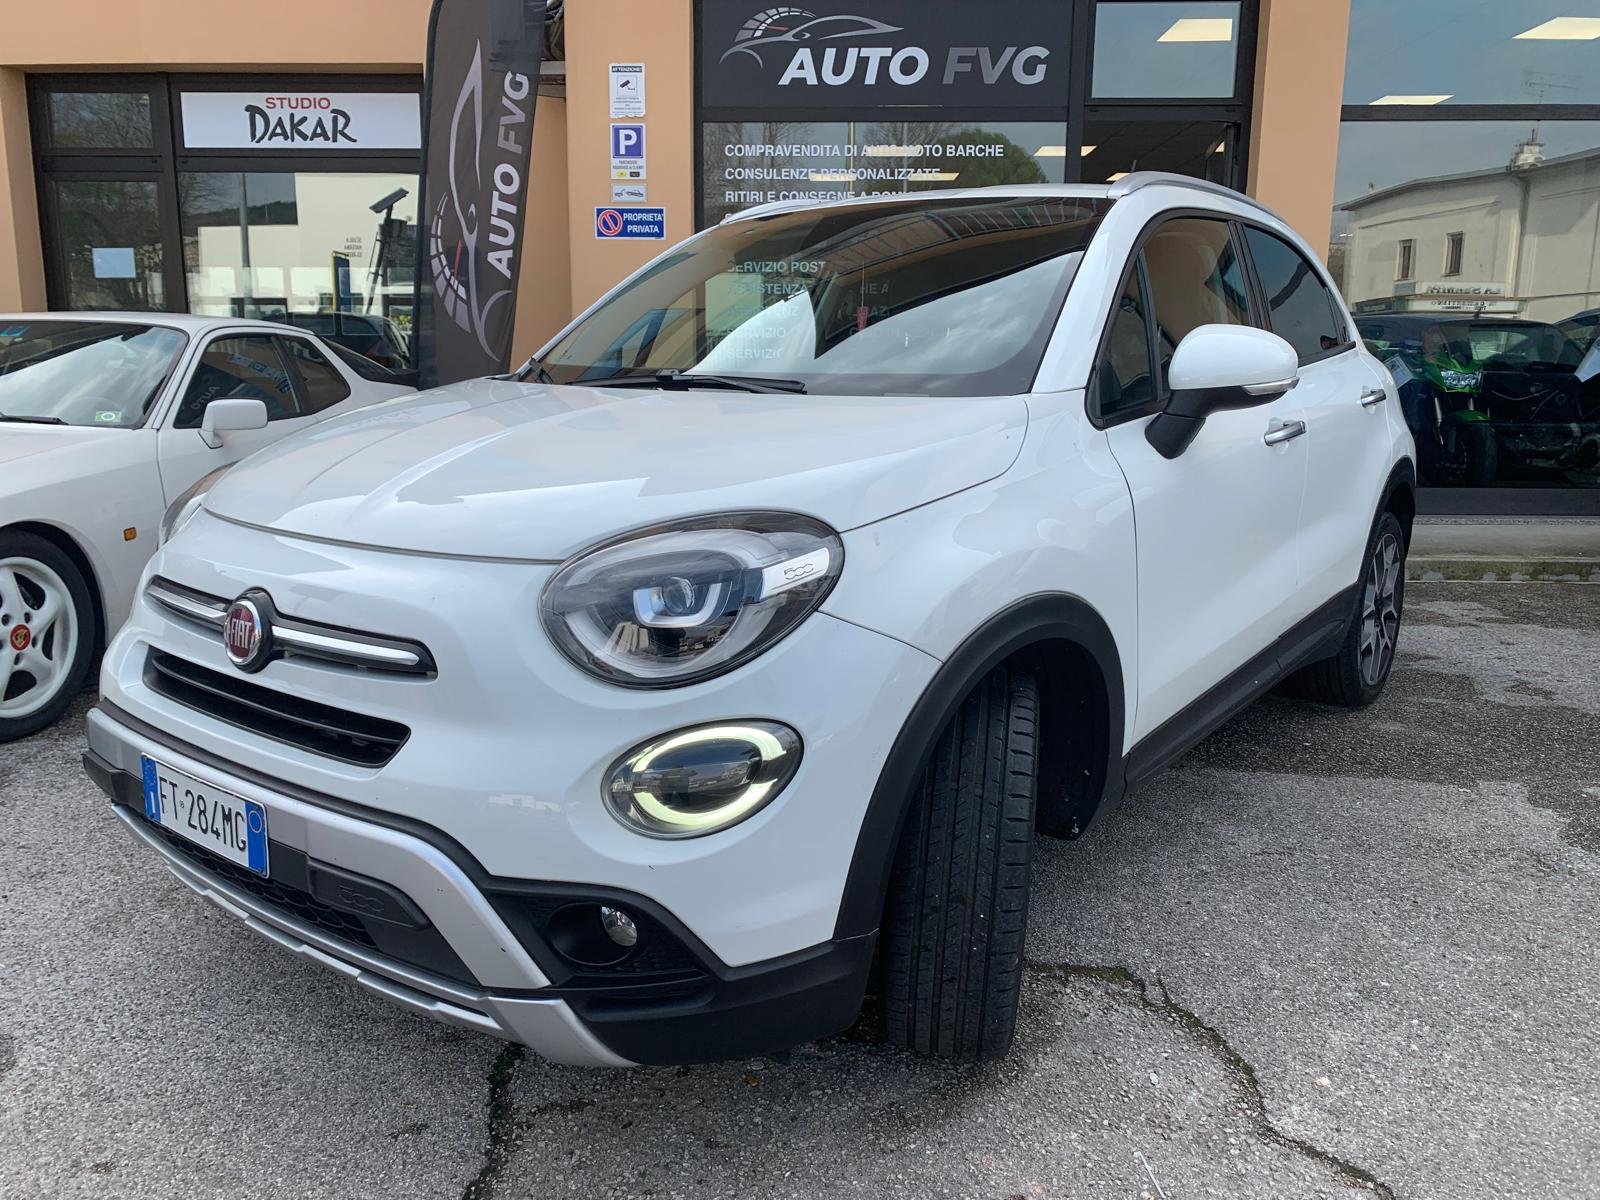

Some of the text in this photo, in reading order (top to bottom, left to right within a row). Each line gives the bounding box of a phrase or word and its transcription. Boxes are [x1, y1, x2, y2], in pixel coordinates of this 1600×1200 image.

[777, 46, 1051, 86] AUTO FVG
[265, 97, 331, 110] STUDIO
[244, 104, 358, 144] DAKAR
[619, 129, 638, 155] P
[724, 144, 841, 157] COMPRAVENDITA
[845, 144, 858, 157] DI
[946, 144, 1004, 157] BARCHE
[487, 71, 529, 279] AUTO FVG
[725, 168, 817, 180] CONSULENZE
[725, 191, 764, 203] RITIRI
[767, 191, 776, 202] E
[627, 224, 660, 233] PRIVATA
[230, 617, 253, 649] FIAT
